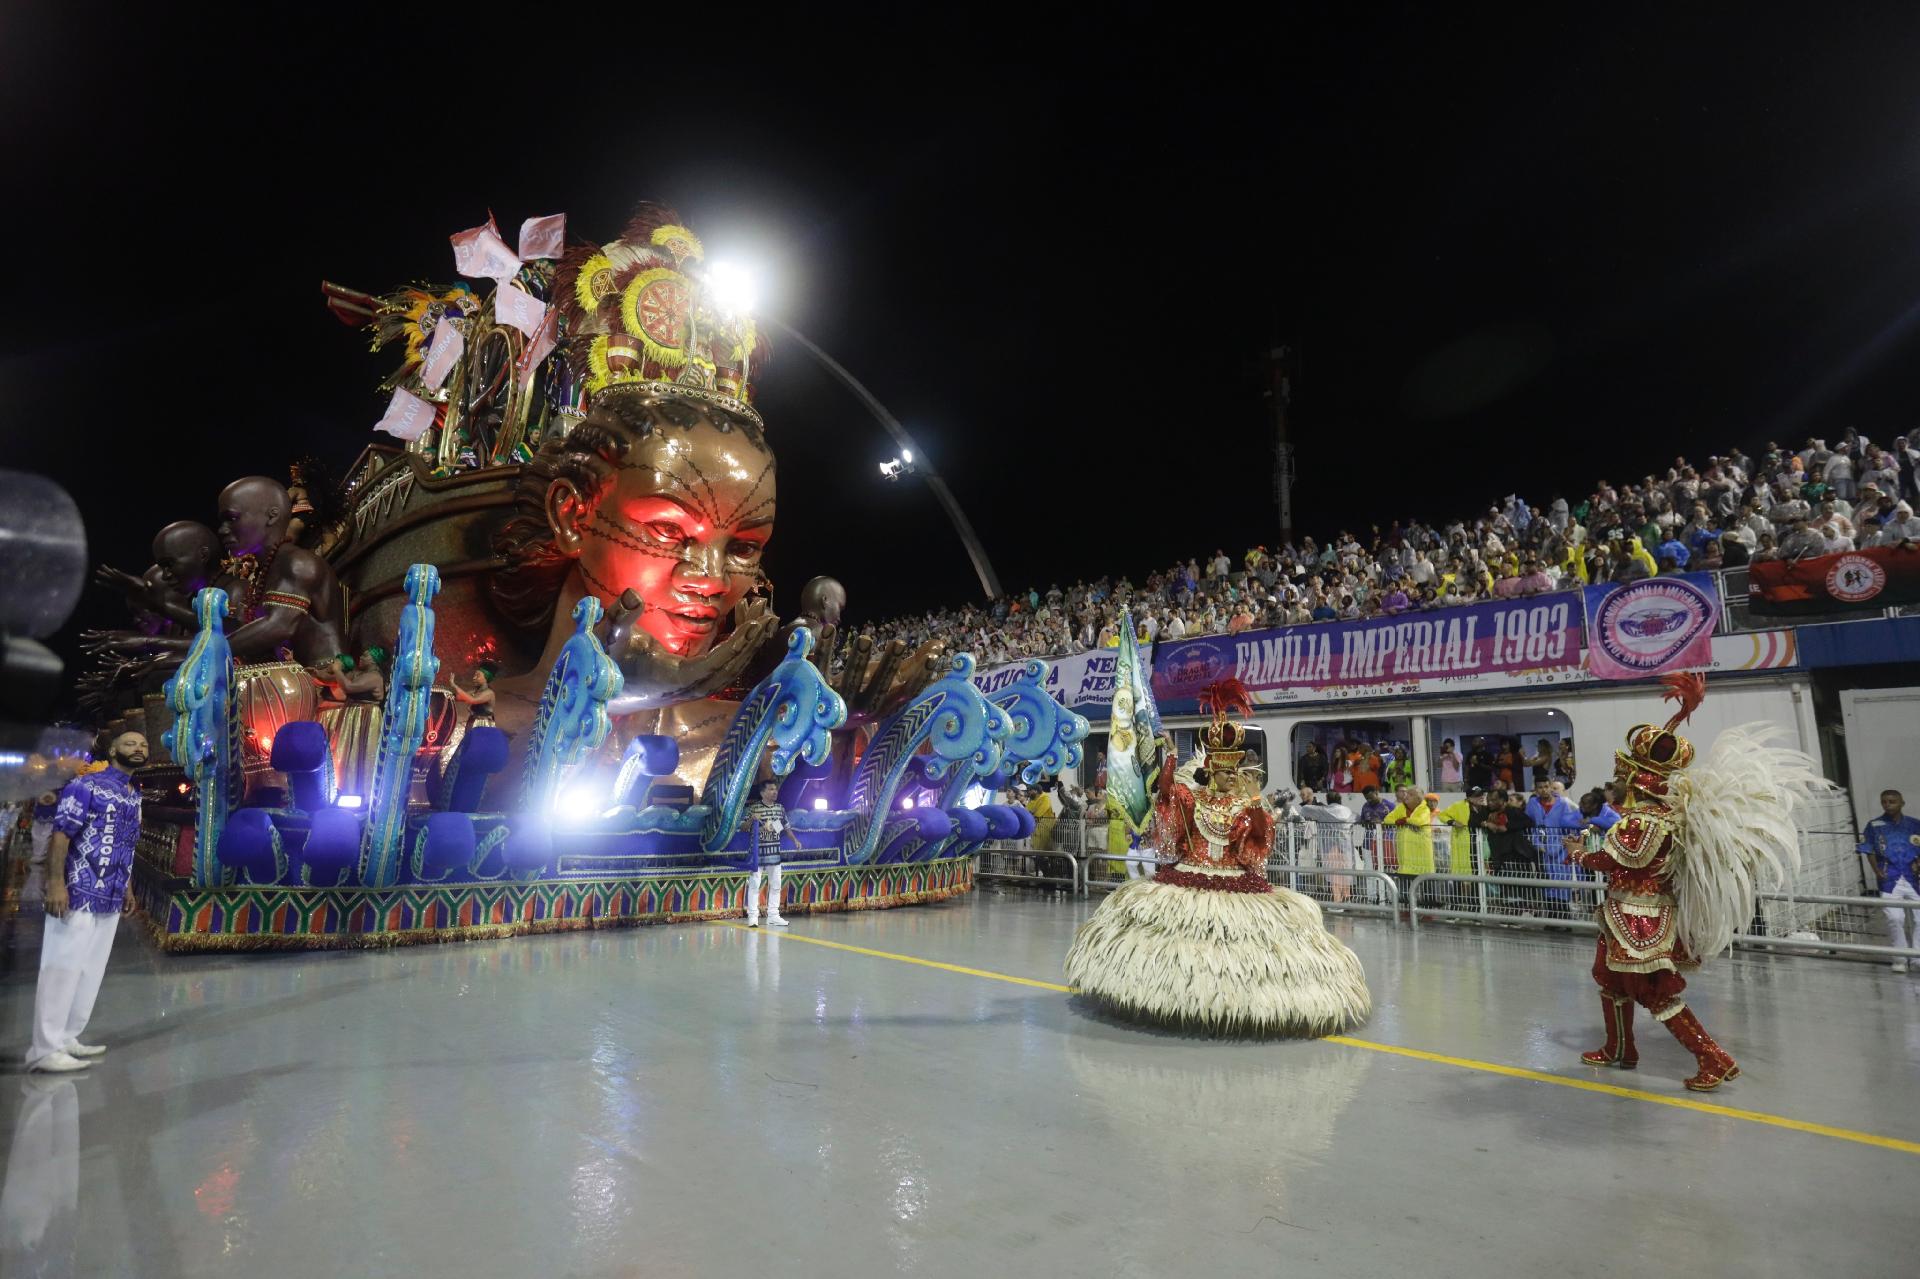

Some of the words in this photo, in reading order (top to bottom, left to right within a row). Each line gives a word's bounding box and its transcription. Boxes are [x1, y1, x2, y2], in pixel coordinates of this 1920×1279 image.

[1235, 628, 1331, 685] FAMÍLIA
[1339, 615, 1481, 680] IMPERIAL
[1491, 602, 1569, 666] 1983
[974, 665, 1058, 694] BATUCA
[1356, 687, 1393, 696] PAULO
[1401, 685, 1420, 693] 202
[94, 803, 117, 889] ALEGORIA
